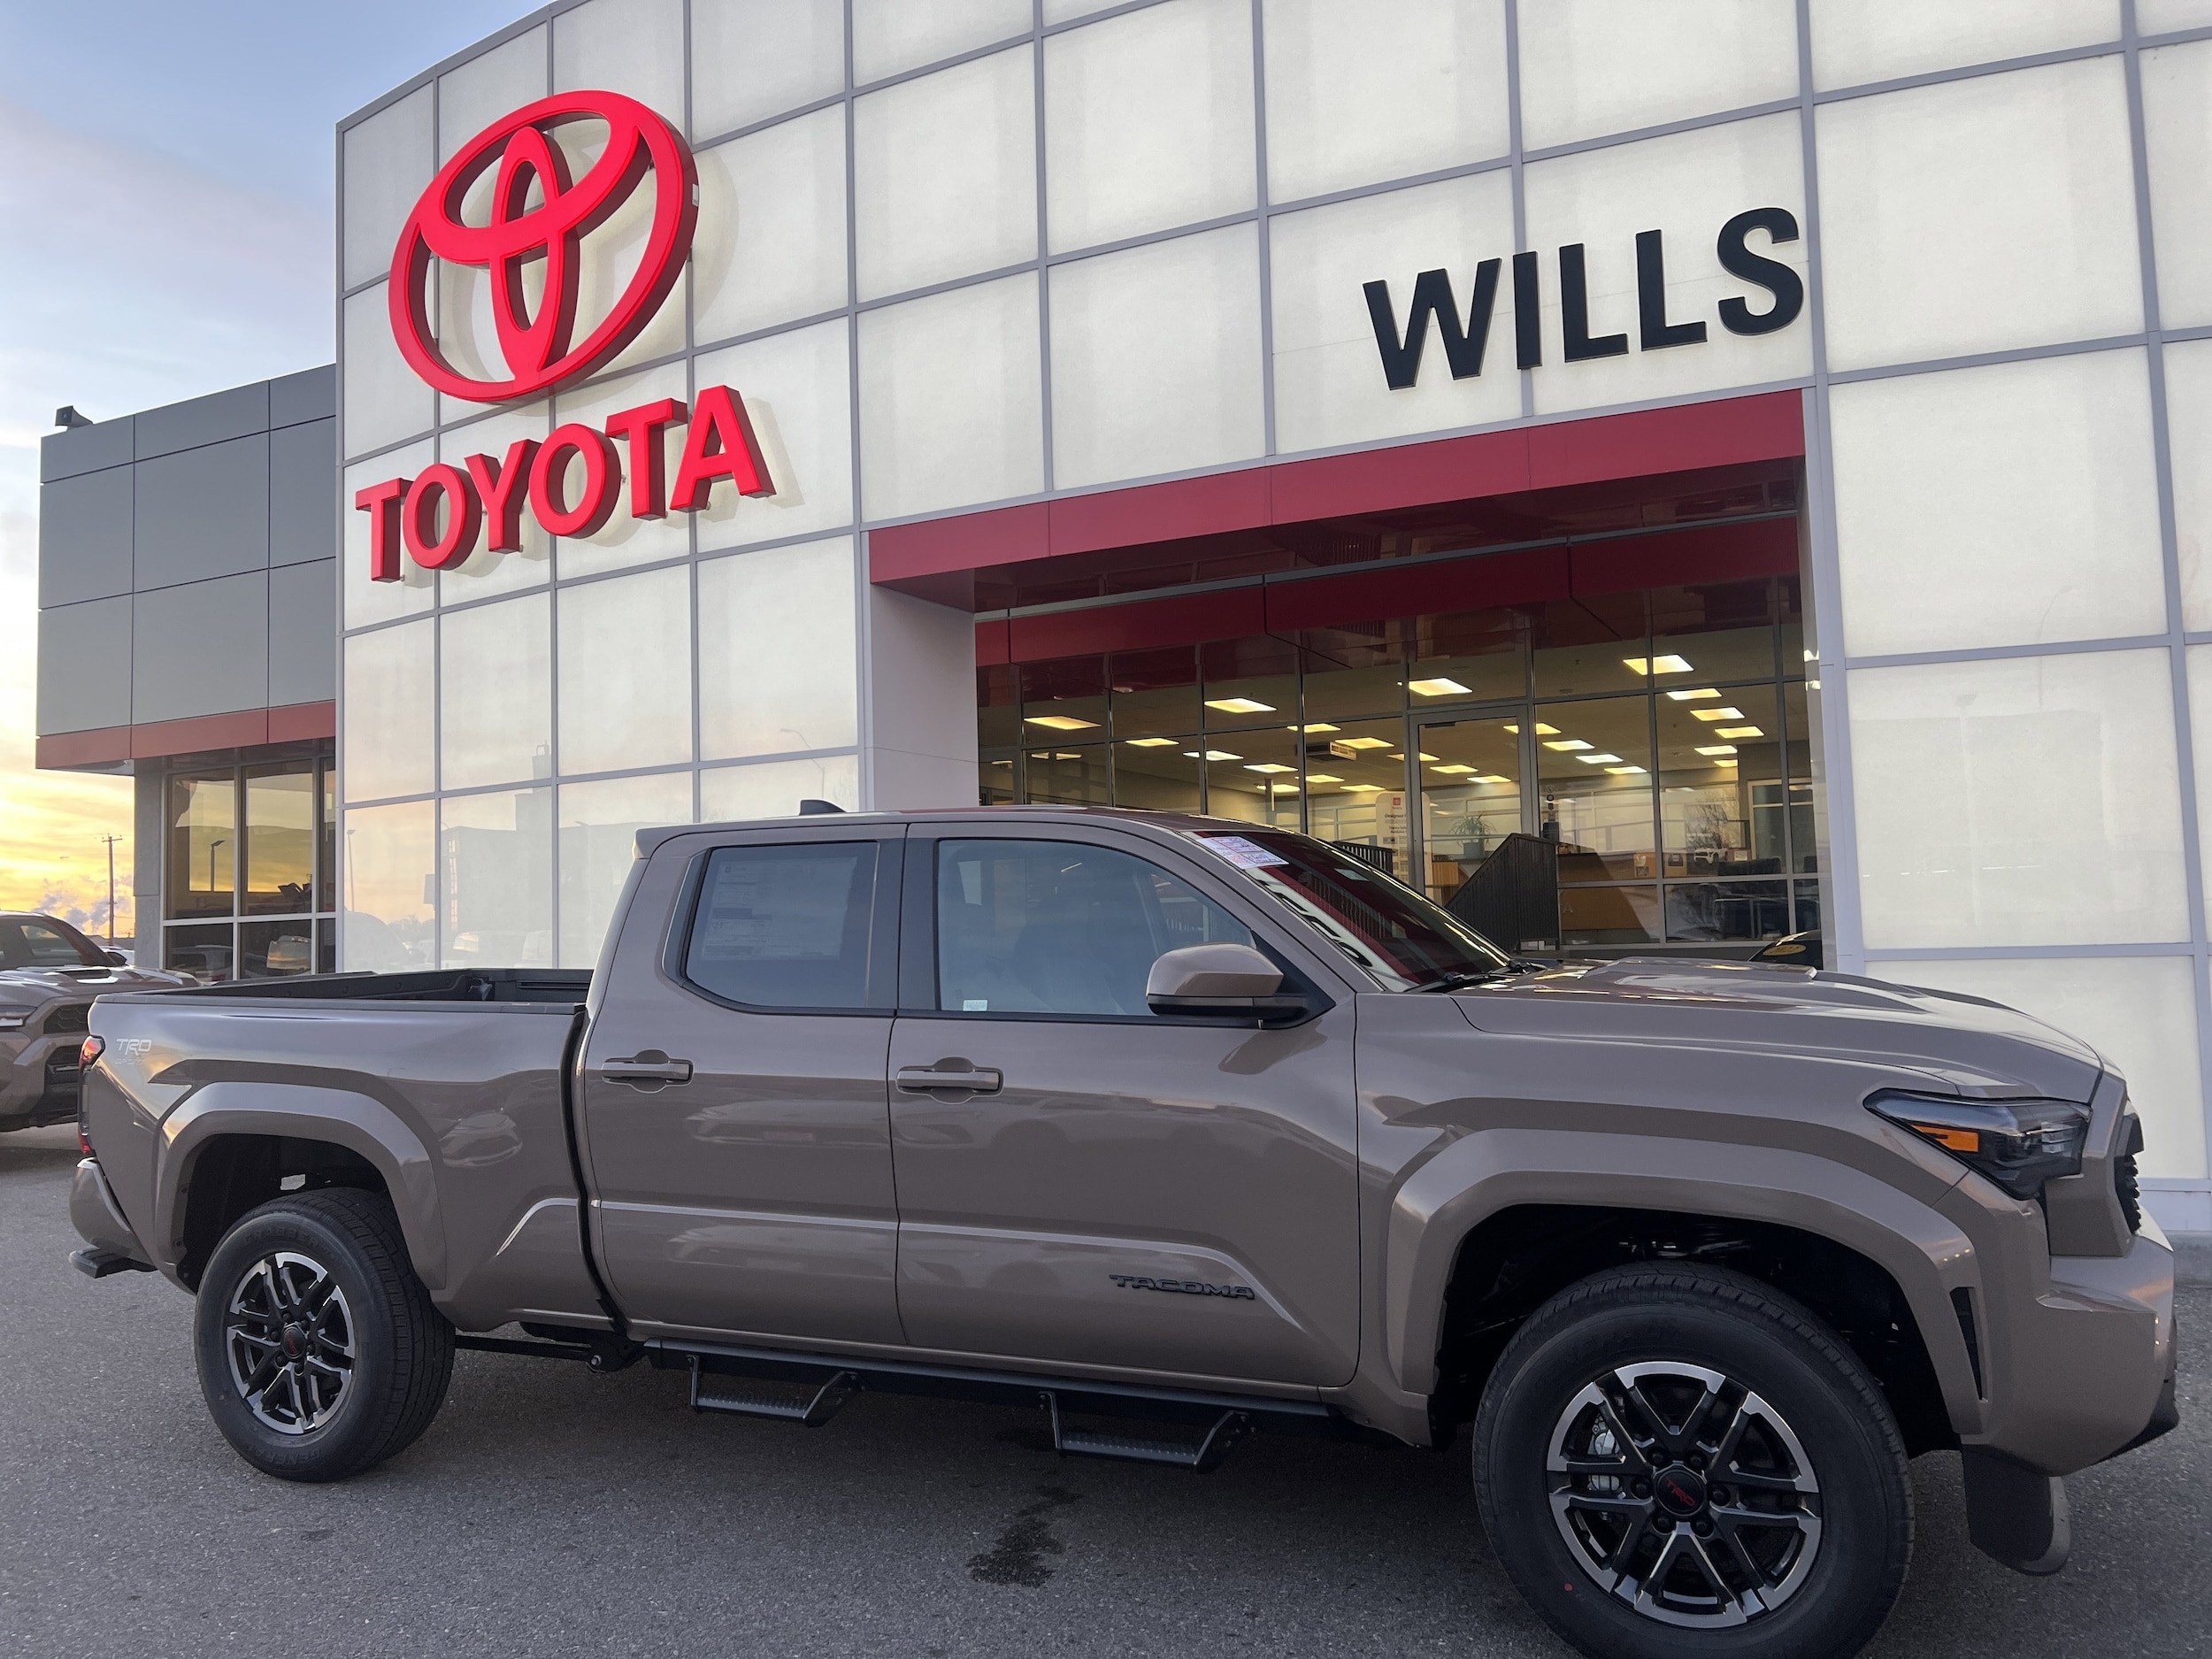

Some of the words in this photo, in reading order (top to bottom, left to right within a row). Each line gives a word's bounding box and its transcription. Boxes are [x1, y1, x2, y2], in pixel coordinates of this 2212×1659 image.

[1363, 207, 1803, 390] WILLS
[356, 384, 776, 583] TOYOTA
[116, 1038, 152, 1056] TRD
[1109, 1274, 1255, 1300] TACOMA
[1665, 1477, 1695, 1507] TRD
